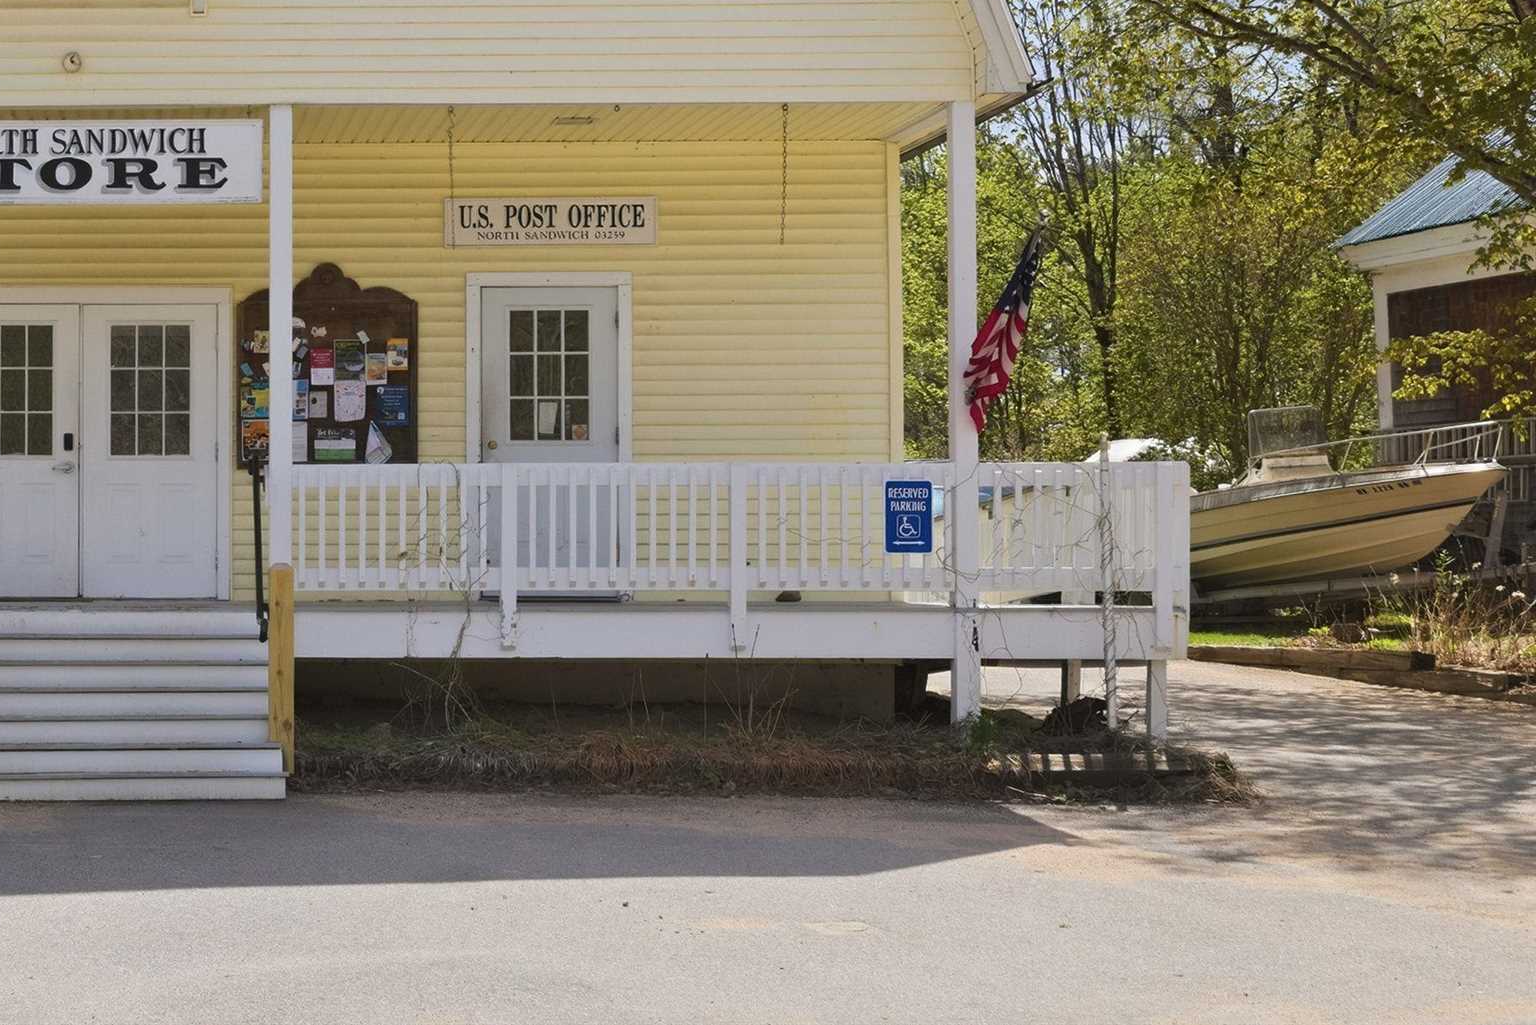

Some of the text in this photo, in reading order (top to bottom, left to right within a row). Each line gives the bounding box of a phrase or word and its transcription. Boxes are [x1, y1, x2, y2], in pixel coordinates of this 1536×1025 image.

[50, 127, 207, 155] SANDWICH
[458, 204, 646, 229] U.S. POST OFFICE
[476, 230, 520, 241] NORTH
[524, 230, 589, 241] SANDWICH
[888, 487, 929, 499] RESERVED
[890, 501, 927, 512] PARKING
